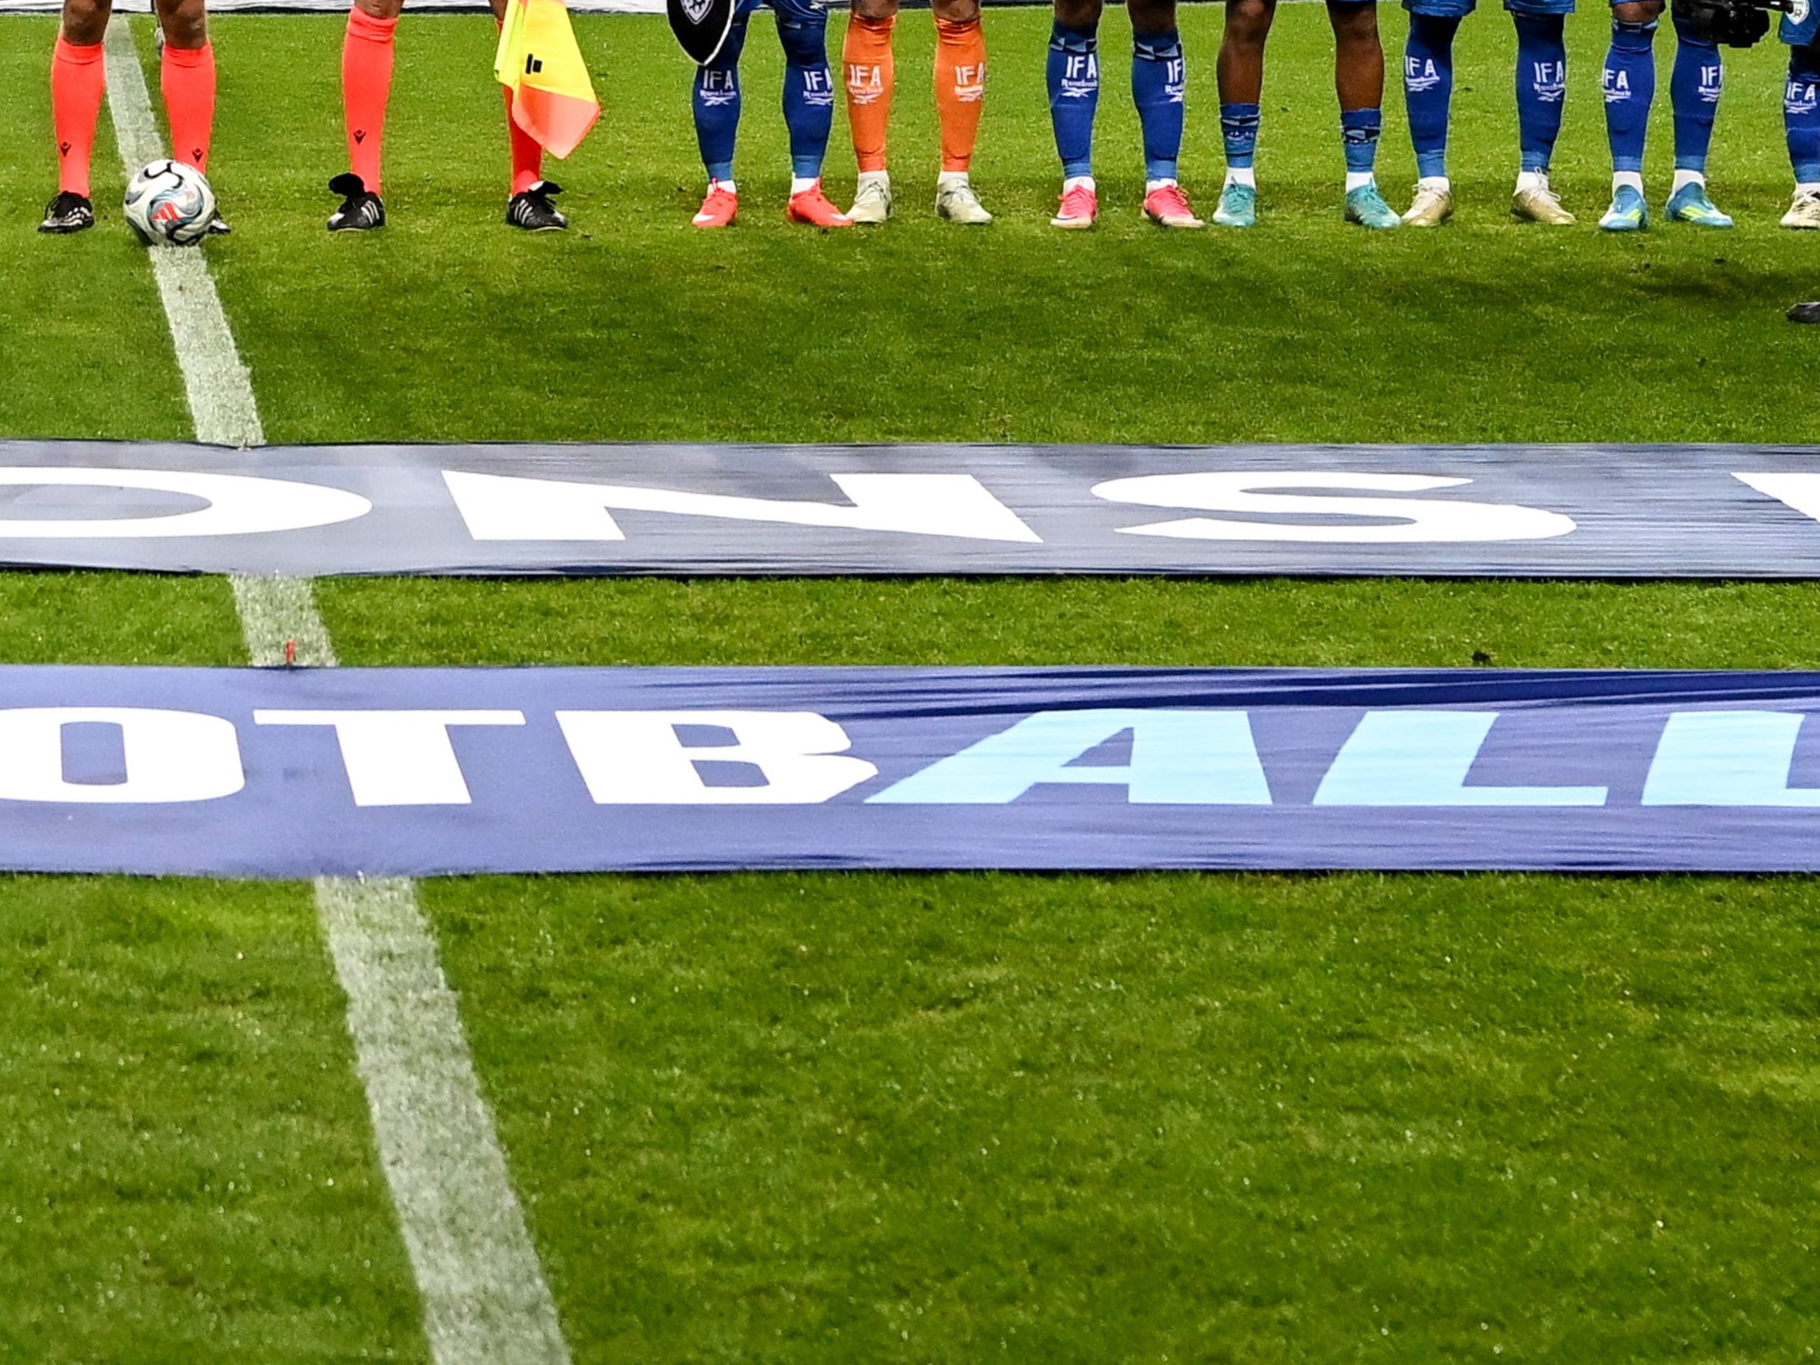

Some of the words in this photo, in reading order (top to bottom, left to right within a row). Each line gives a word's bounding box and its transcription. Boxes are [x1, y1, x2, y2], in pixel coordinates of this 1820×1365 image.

[849, 65, 881, 86] IFA
[955, 62, 984, 85] IFA
[1065, 54, 1097, 79] IFA
[1166, 59, 1182, 80] IF
[1405, 55, 1437, 77] IFA
[1534, 61, 1564, 83] IFA
[703, 70, 734, 89] IFA
[804, 68, 833, 90] IFA
[1605, 69, 1629, 89] FA
[1786, 82, 1816, 100] IFA
